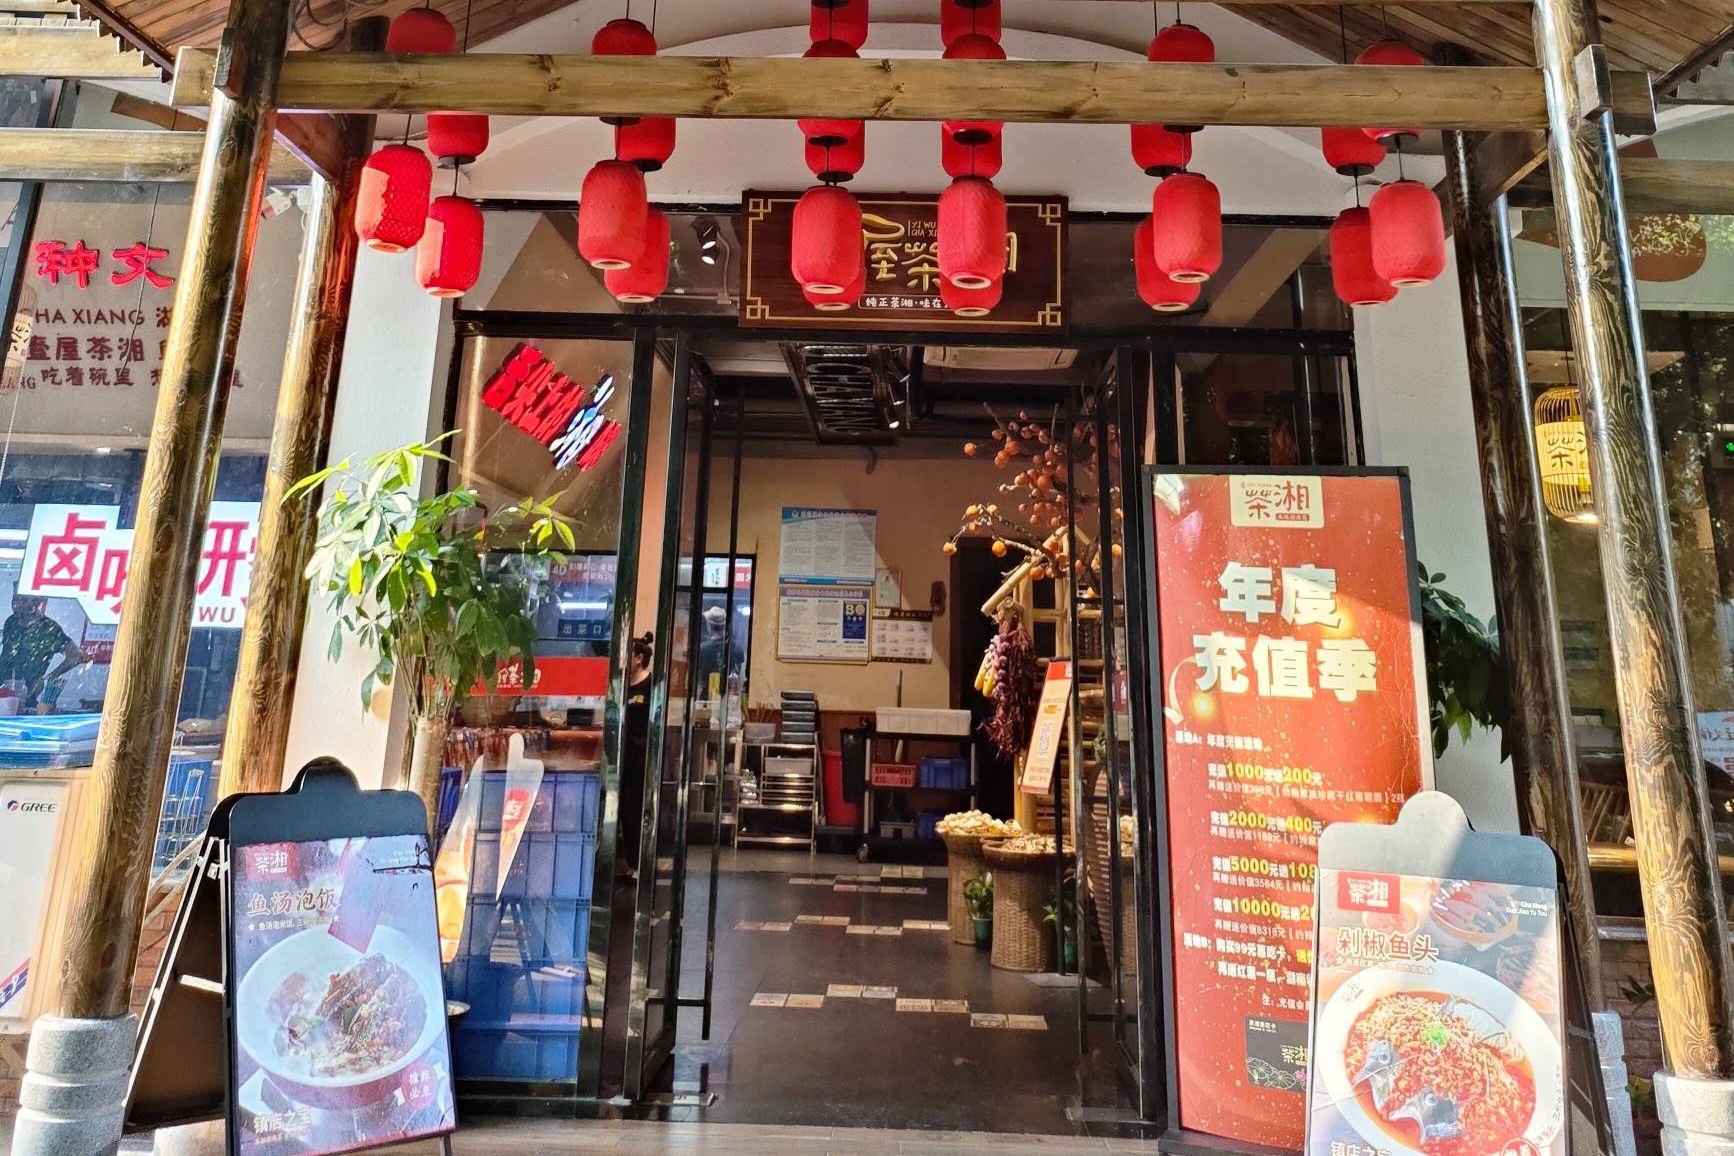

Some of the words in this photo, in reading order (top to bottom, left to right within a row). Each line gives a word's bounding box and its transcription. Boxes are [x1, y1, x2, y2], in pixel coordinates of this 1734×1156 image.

[923, 221, 936, 229] WU
[865, 296, 949, 309] 纯正茶湘·味在
[34, 308, 67, 325] HA
[72, 308, 146, 326] XIANG
[1217, 561, 1342, 629] 年度
[1192, 630, 1378, 703] 充值季
[20, 802, 58, 813] GREE
[1212, 855, 1317, 879] 充值5000元送108
[246, 888, 340, 917] 鱼汤泡饭
[1336, 926, 1439, 963] 剁椒鱼头
